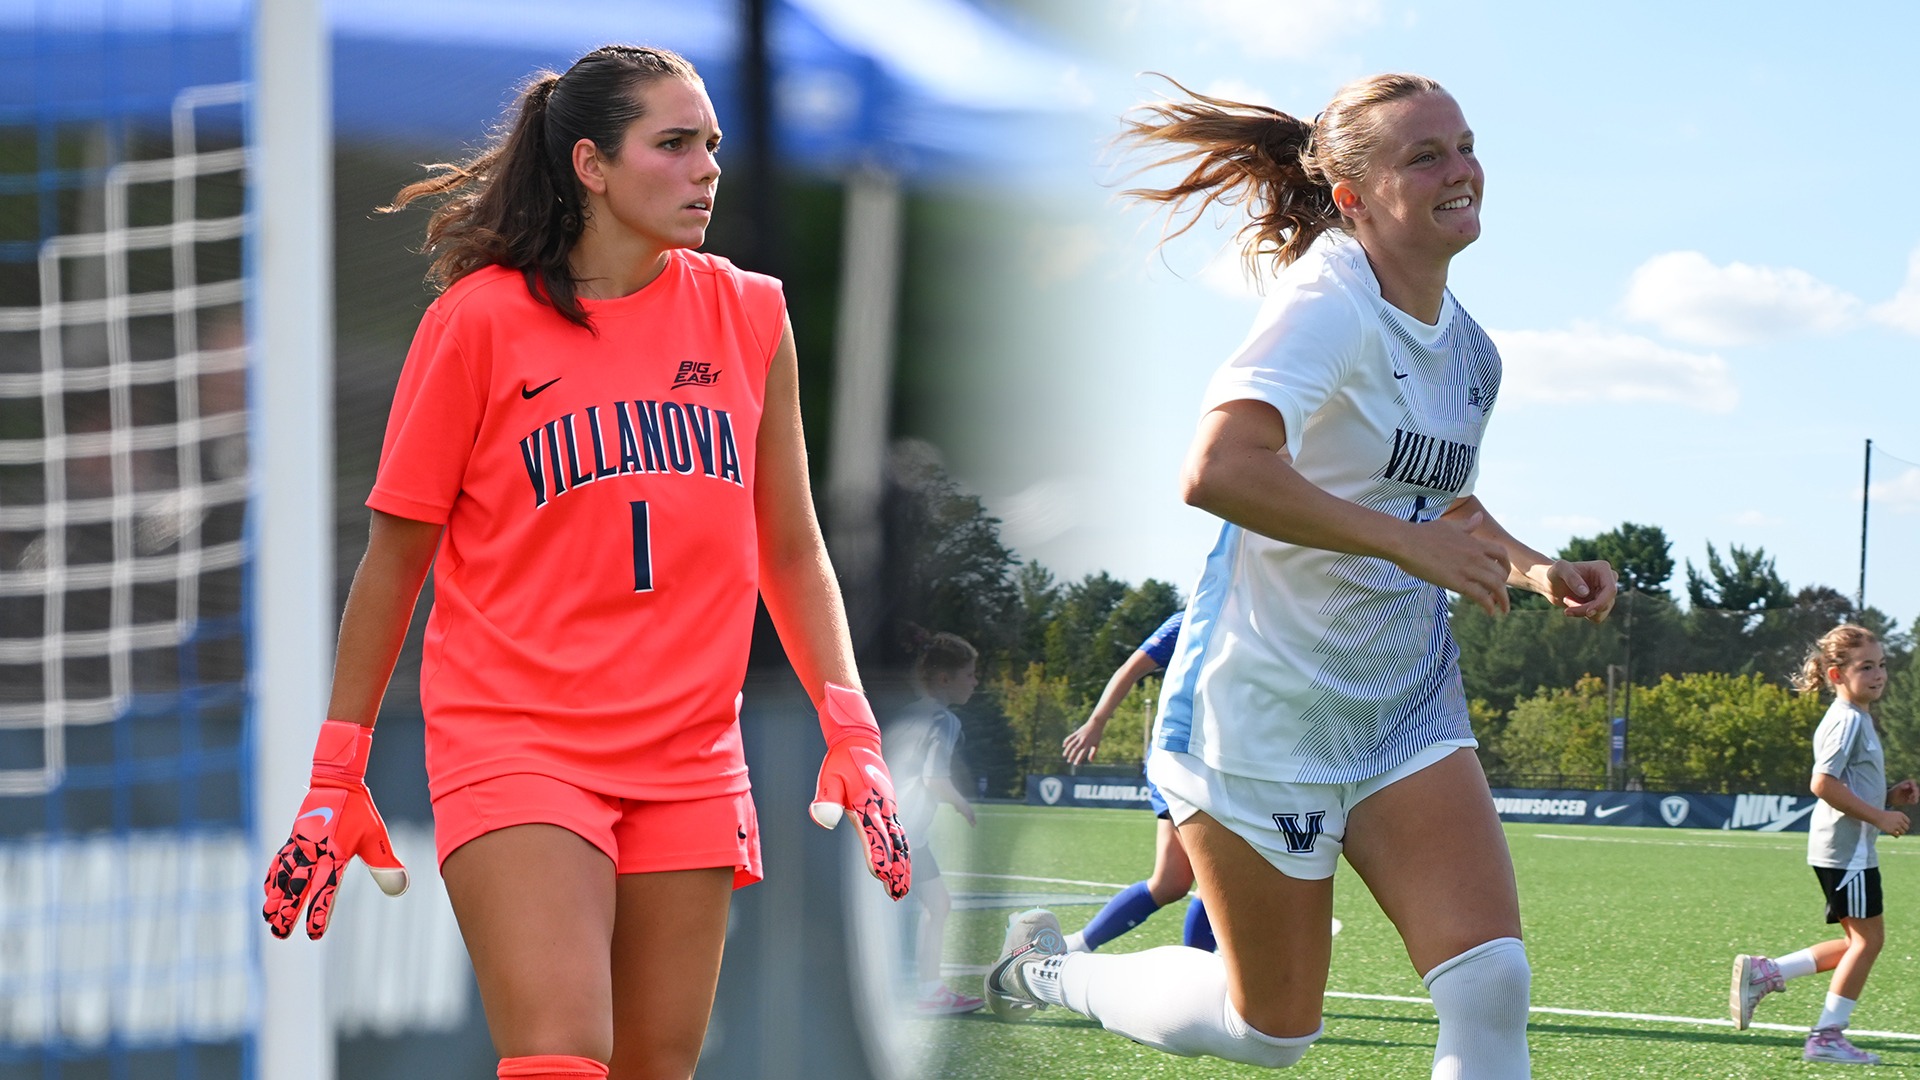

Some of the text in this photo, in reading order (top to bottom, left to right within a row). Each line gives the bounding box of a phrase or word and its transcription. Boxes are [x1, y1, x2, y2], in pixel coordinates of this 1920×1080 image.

[674, 370, 722, 384] EAST
[678, 361, 711, 373] BIG
[519, 400, 744, 509] VILLANOVA
[1384, 428, 1478, 493] VILLANOV
[629, 500, 654, 593] 1
[1272, 810, 1326, 853] V
[1731, 794, 1797, 829] NIKE
